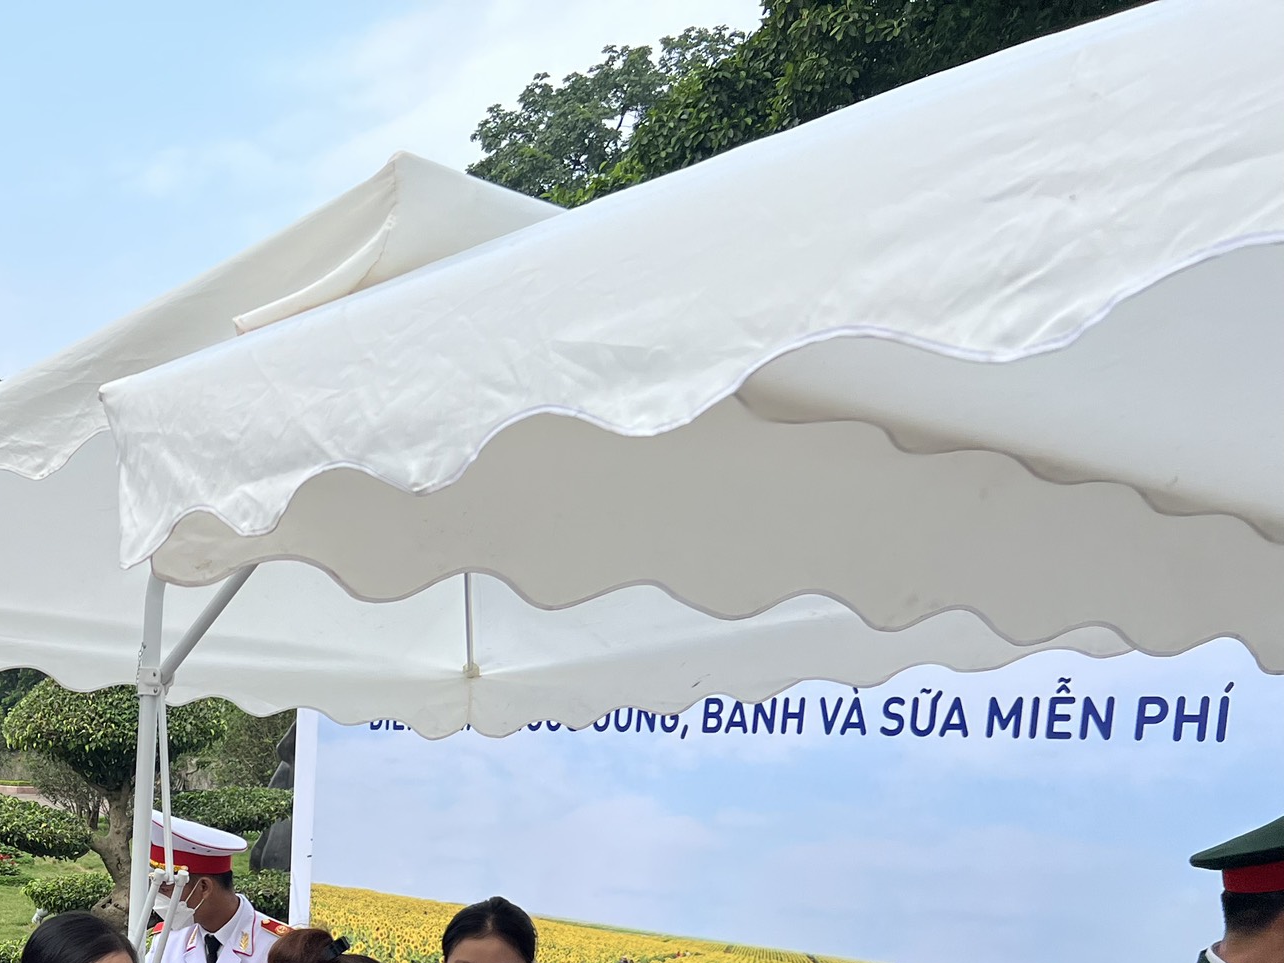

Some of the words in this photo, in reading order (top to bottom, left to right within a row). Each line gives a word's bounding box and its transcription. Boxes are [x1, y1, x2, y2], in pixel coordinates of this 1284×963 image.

[819, 687, 867, 736] VÀ
[879, 687, 969, 738] SỮA
[985, 676, 1116, 740] MIỄN
[1134, 681, 1235, 743] PHÍ
